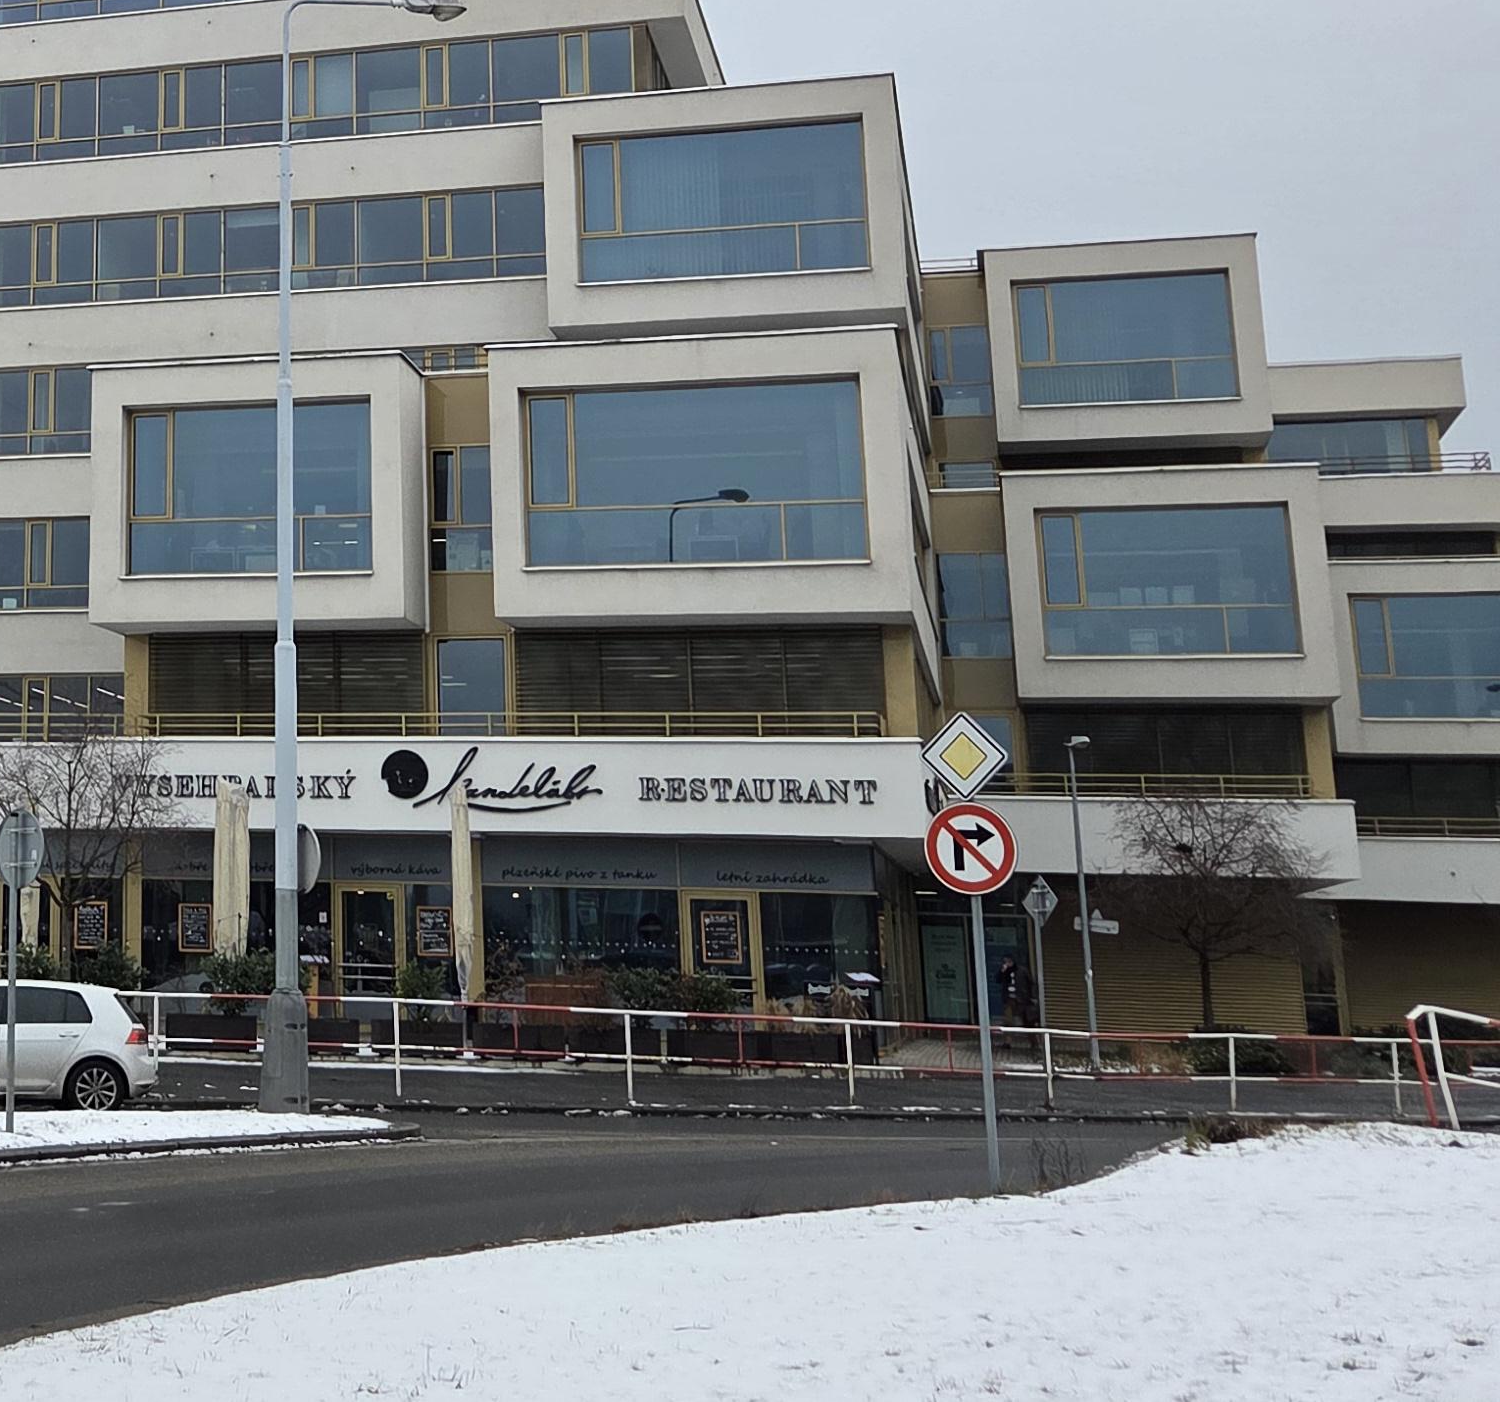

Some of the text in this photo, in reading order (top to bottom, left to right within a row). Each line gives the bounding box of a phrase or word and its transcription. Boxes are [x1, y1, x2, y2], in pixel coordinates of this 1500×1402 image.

[638, 776, 878, 805] RESTAURANT
[350, 863, 442, 877] výborná káva
[502, 865, 658, 880] plzeňské pivo z tanku
[716, 869, 830, 885] letní zahrádka
